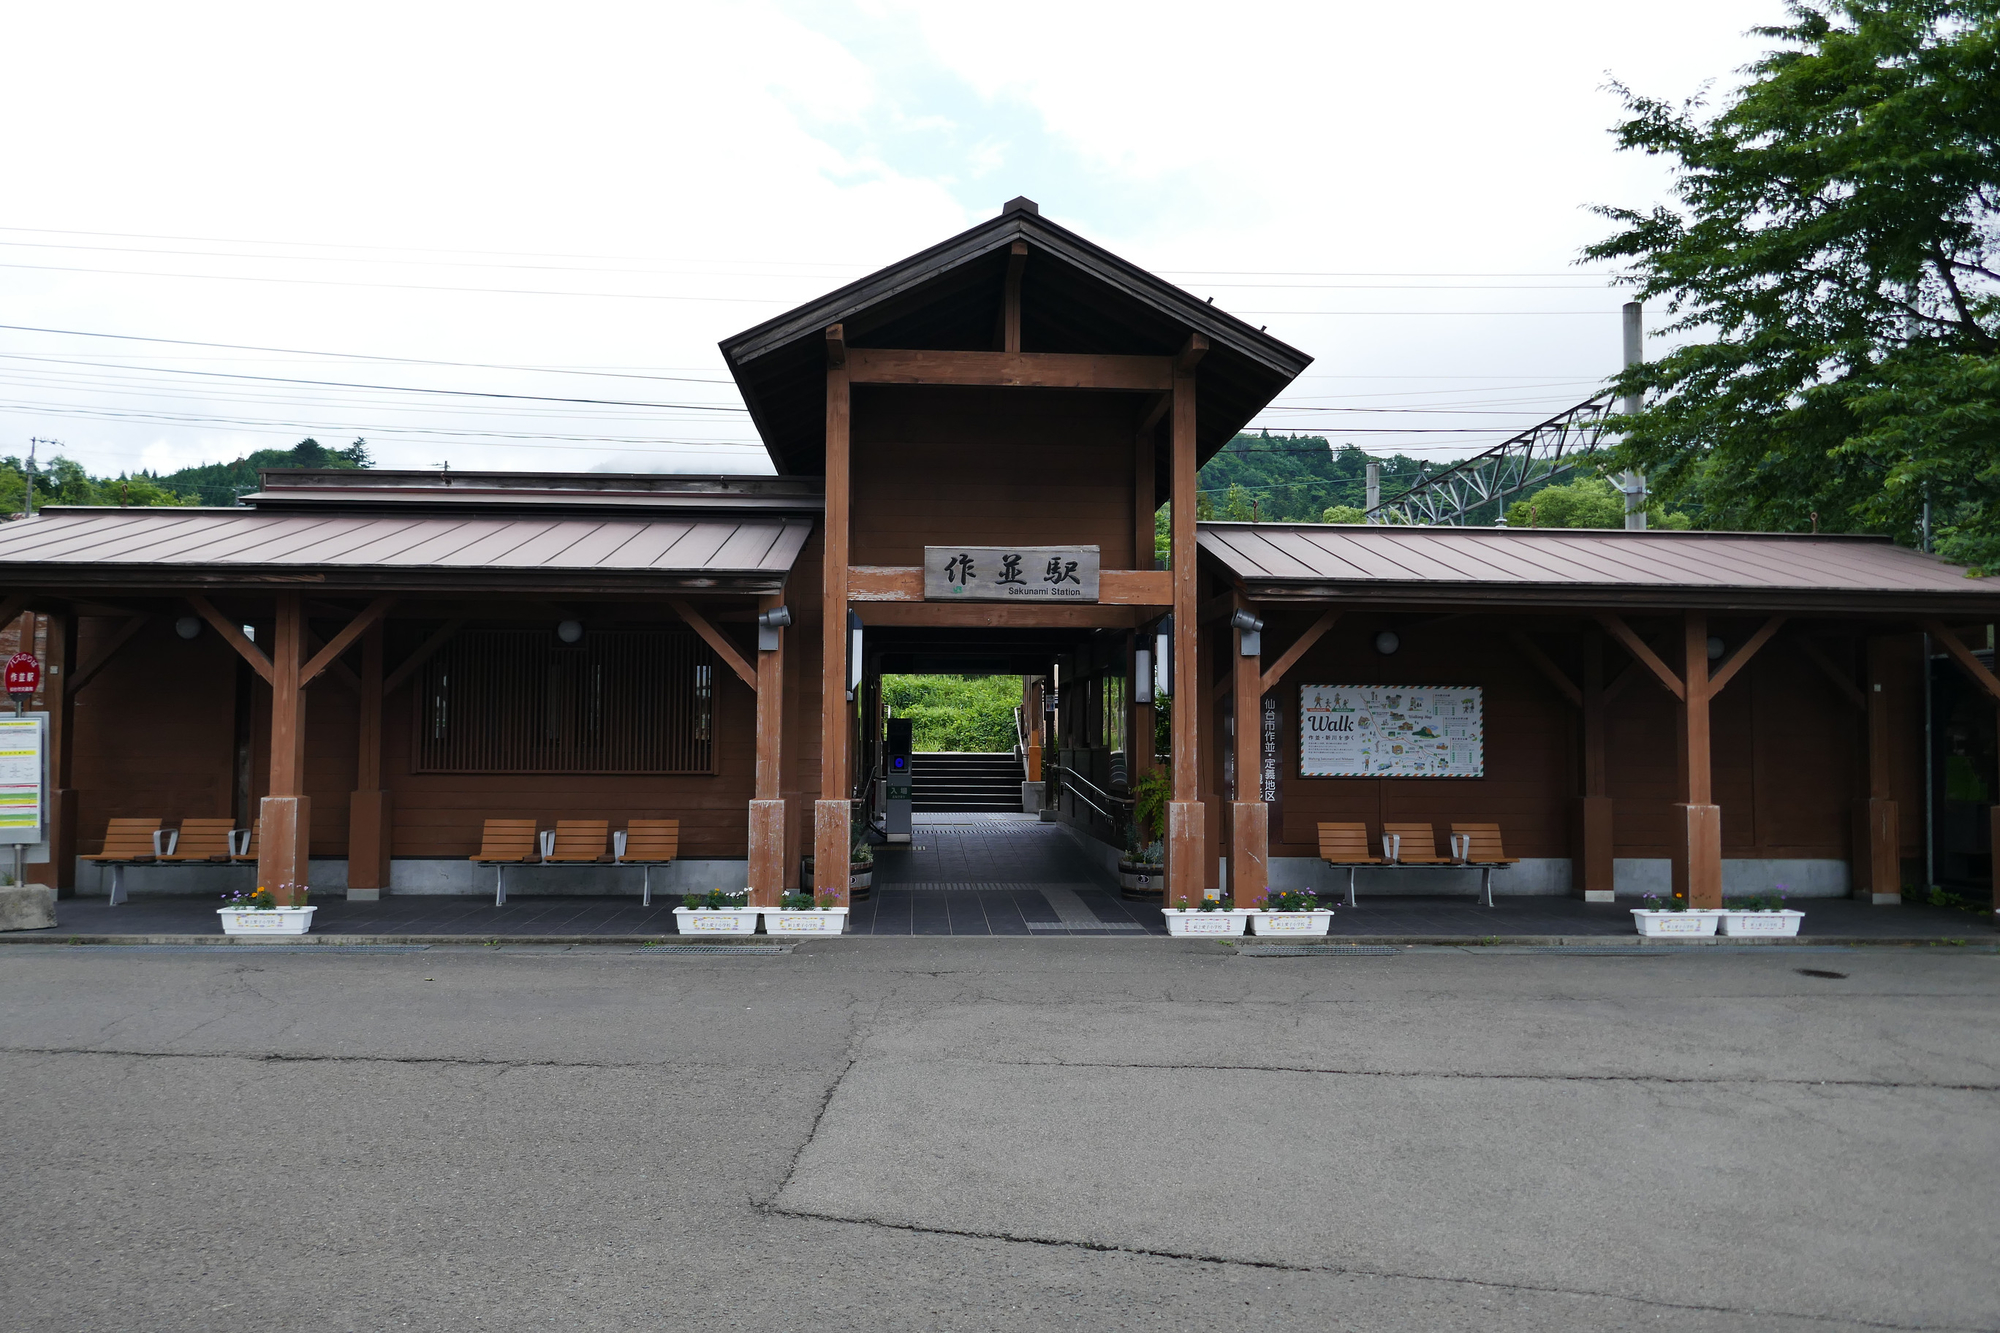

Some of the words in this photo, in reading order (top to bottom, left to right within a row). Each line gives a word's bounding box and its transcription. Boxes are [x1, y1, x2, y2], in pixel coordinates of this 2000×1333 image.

[944, 553, 1081, 586] 作並駅
[1008, 587, 1049, 596] Sakunami
[1051, 587, 1081, 596] Station
[10, 654, 38, 668] バスのりば
[11, 672, 35, 682] 作並駅
[1307, 715, 1354, 732] Walk
[1264, 699, 1276, 801] 仙台市作並・定義地区
